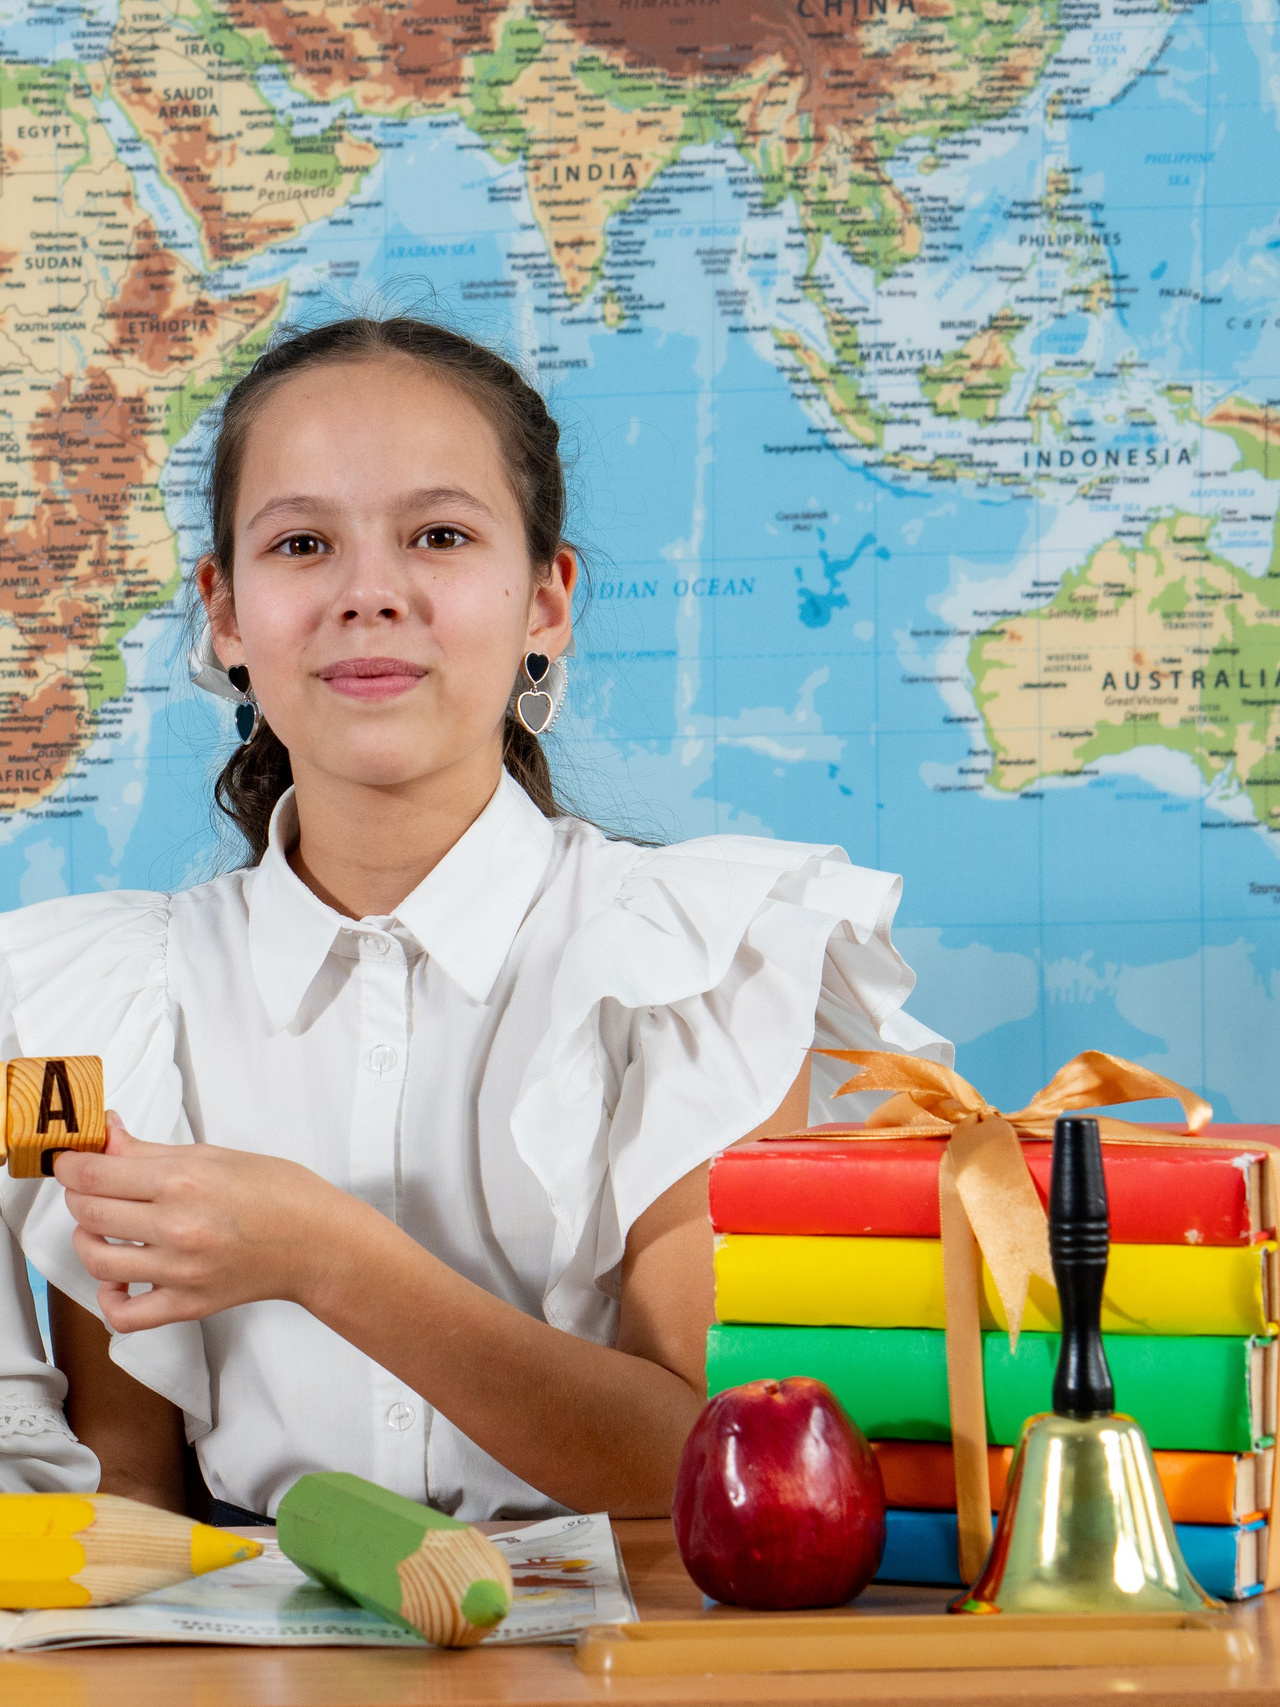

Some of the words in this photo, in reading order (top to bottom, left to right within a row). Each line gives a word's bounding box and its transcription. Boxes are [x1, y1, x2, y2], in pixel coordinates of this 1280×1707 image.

[797, 0, 915, 17] CHINA
[185, 42, 224, 56] IRAQ
[305, 49, 344, 62] IRAN
[164, 87, 213, 101] SAUDI
[158, 105, 218, 118] ARABIA
[19, 126, 71, 138] EGYPT
[265, 167, 328, 181] Arabian
[553, 163, 636, 181] INDIA
[1020, 233, 1121, 247] PHILIPPINES
[25, 257, 82, 270] SUDAN
[128, 320, 209, 333] ETHIOPIA
[860, 350, 943, 362] MALAYSIA
[131, 405, 170, 414] KENYA
[1024, 449, 1191, 467] INDONESIA
[86, 493, 150, 503] TANZANIA
[600, 580, 658, 600] DIAN
[673, 577, 755, 597] OCEAN
